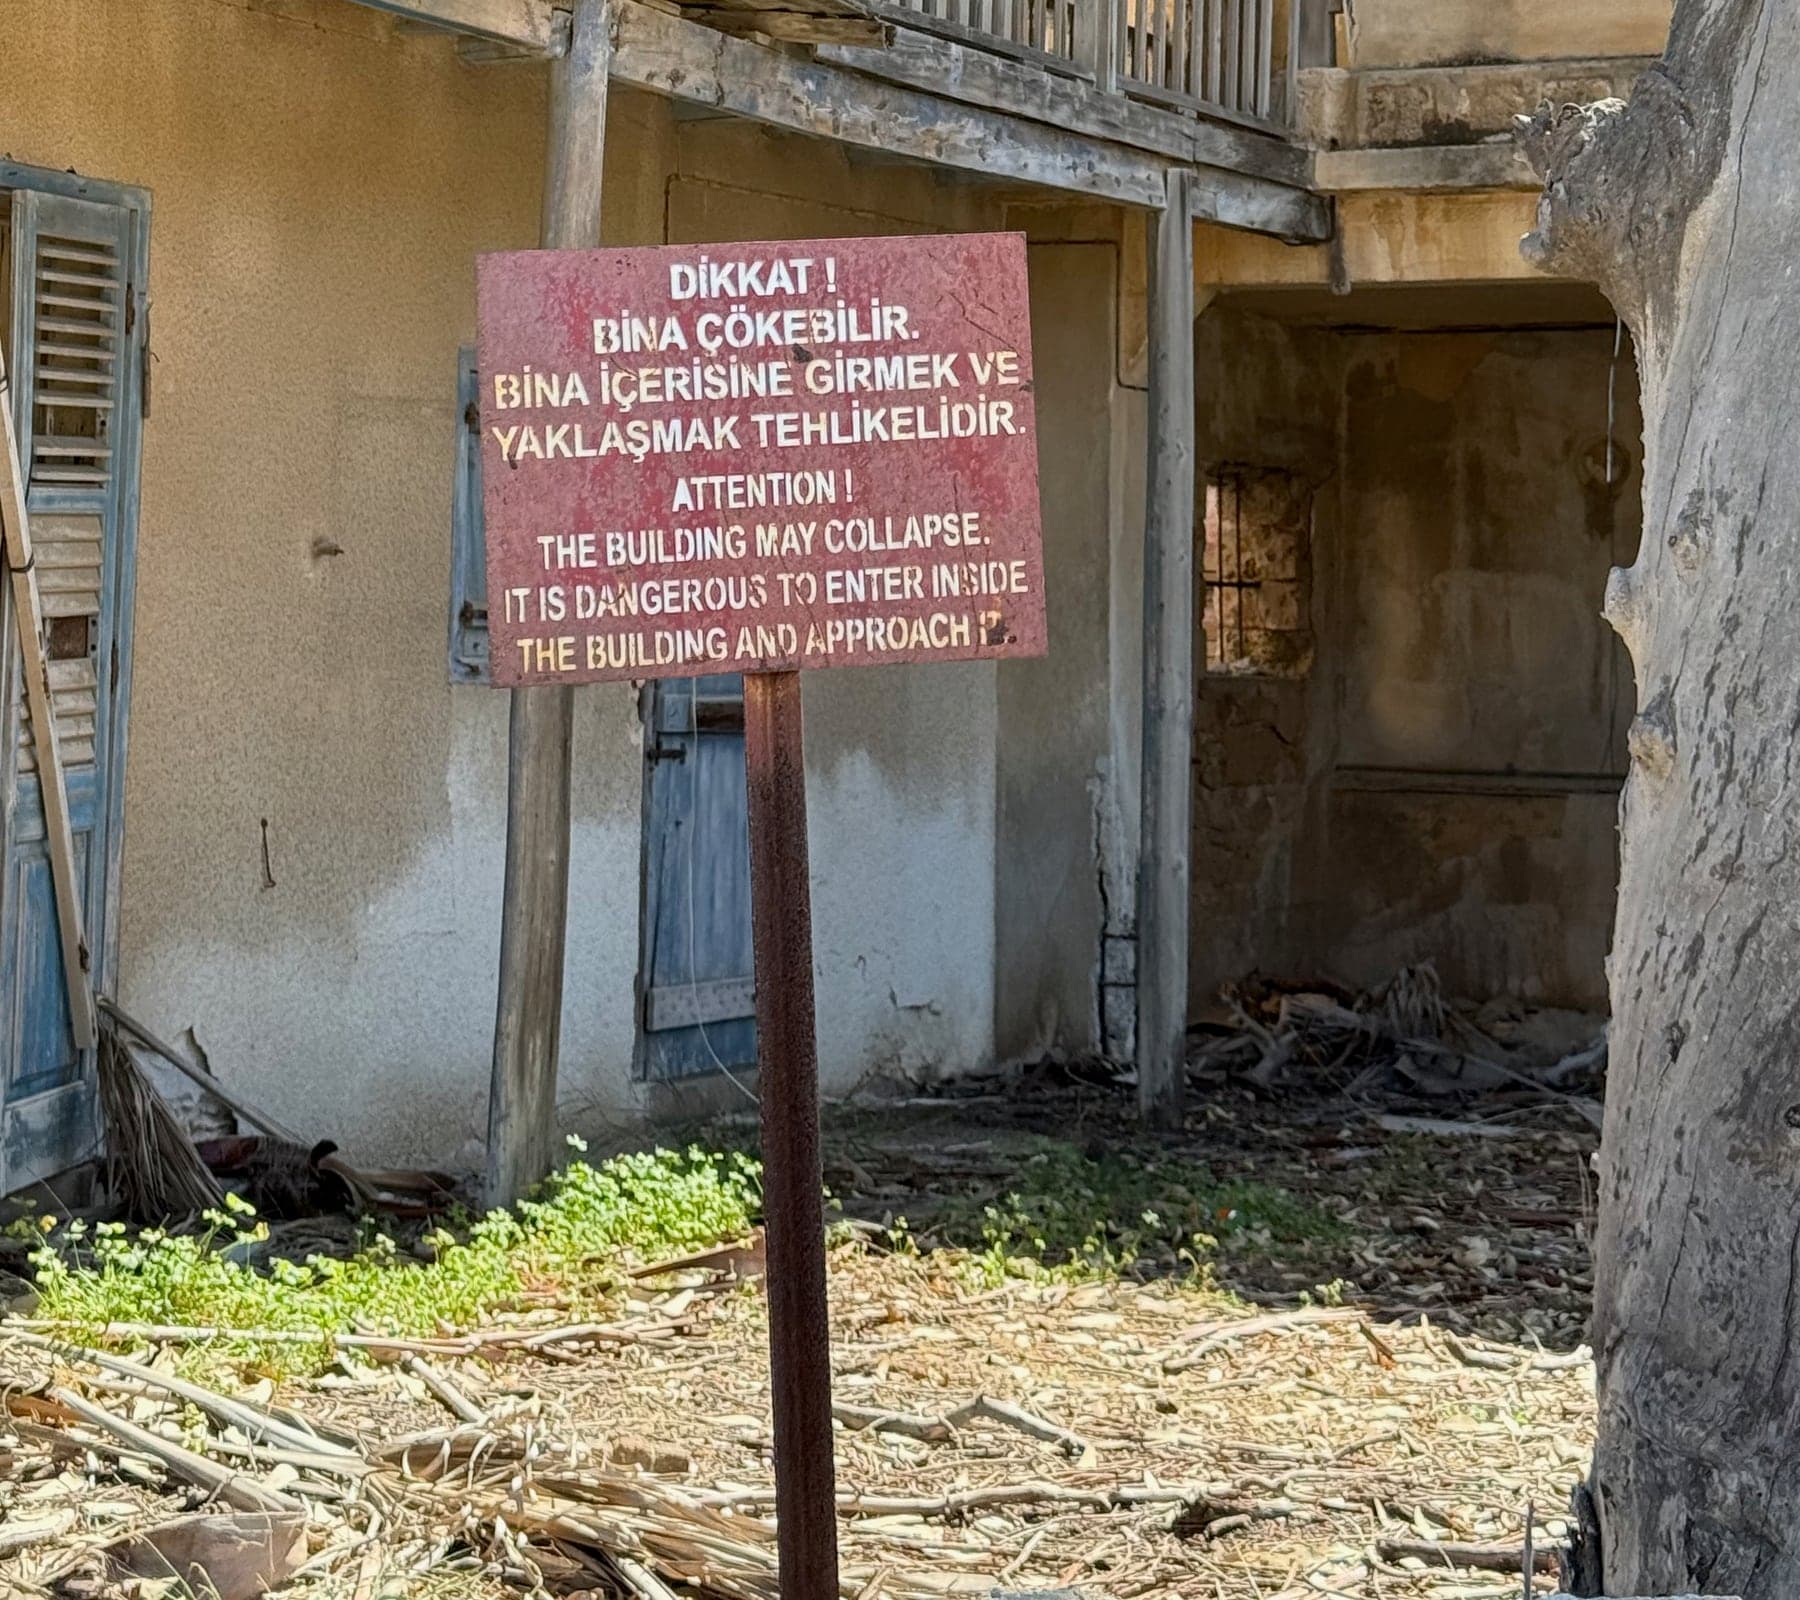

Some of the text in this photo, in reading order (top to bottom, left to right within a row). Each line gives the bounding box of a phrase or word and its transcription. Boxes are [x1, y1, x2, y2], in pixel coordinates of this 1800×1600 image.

[670, 255, 836, 300] DİKKAT !
[593, 297, 919, 357] BİNA ÇÖKEBİLİR.
[494, 350, 1019, 412] BİNA İÇERİSİNE GİRMEK VE
[492, 393, 1026, 463] YAKLAŞMAK TEHLİKELİDİR.
[672, 468, 853, 512] ATTENTION !
[537, 512, 991, 570] THE BUILDING MAY COLLAPSE.
[505, 560, 1029, 625] IT IS DANGEROUS TO ENTER INSIDE
[517, 636, 577, 673] THE
[586, 627, 727, 670] BUILDING
[734, 623, 797, 660] AND
[805, 612, 970, 655] APPROACH
